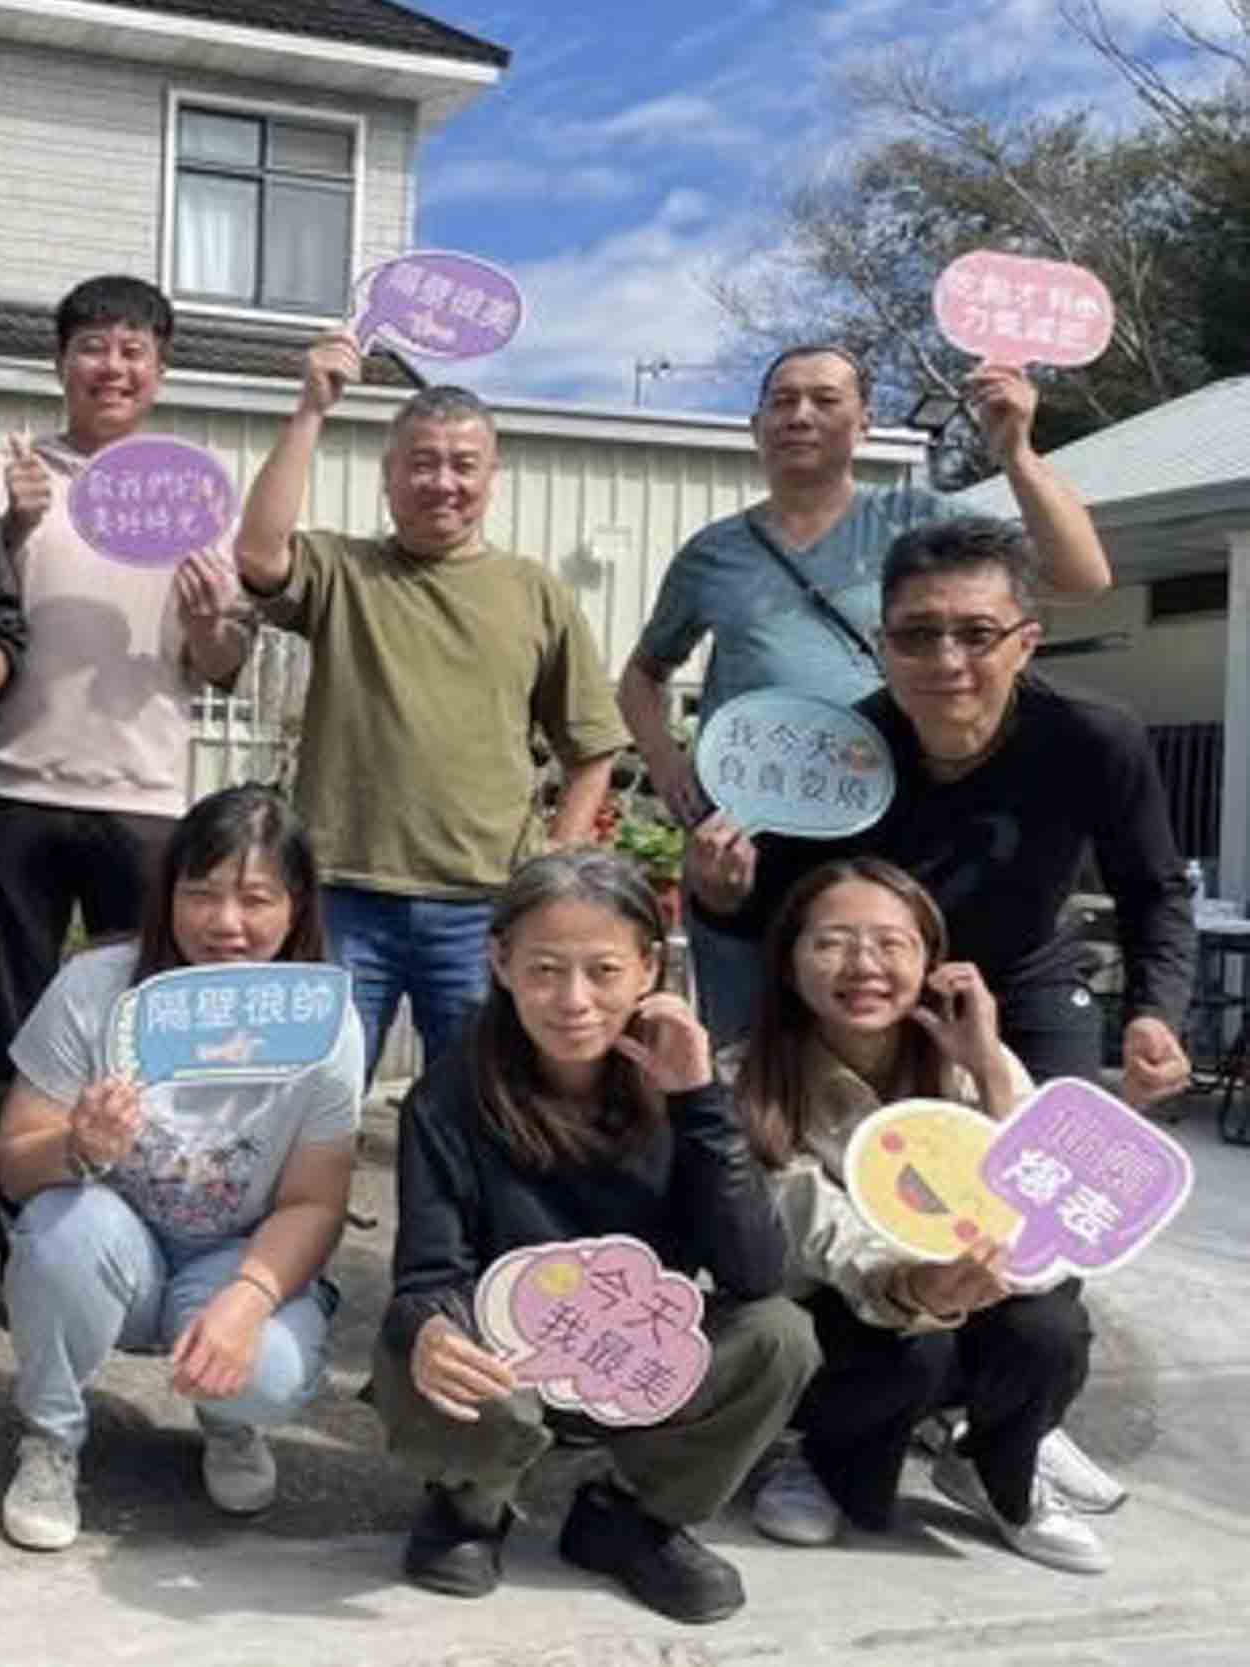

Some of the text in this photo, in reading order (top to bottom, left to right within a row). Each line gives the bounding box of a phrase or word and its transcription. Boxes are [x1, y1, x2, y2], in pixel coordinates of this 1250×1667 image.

[724, 715, 837, 760] 我今天
[718, 755, 860, 808] 負責耍廢
[145, 978, 337, 1034] 隔壁很帥
[1002, 1146, 1127, 1244] 爆表
[588, 1266, 690, 1348] 今天
[538, 1300, 678, 1410] 我最美
